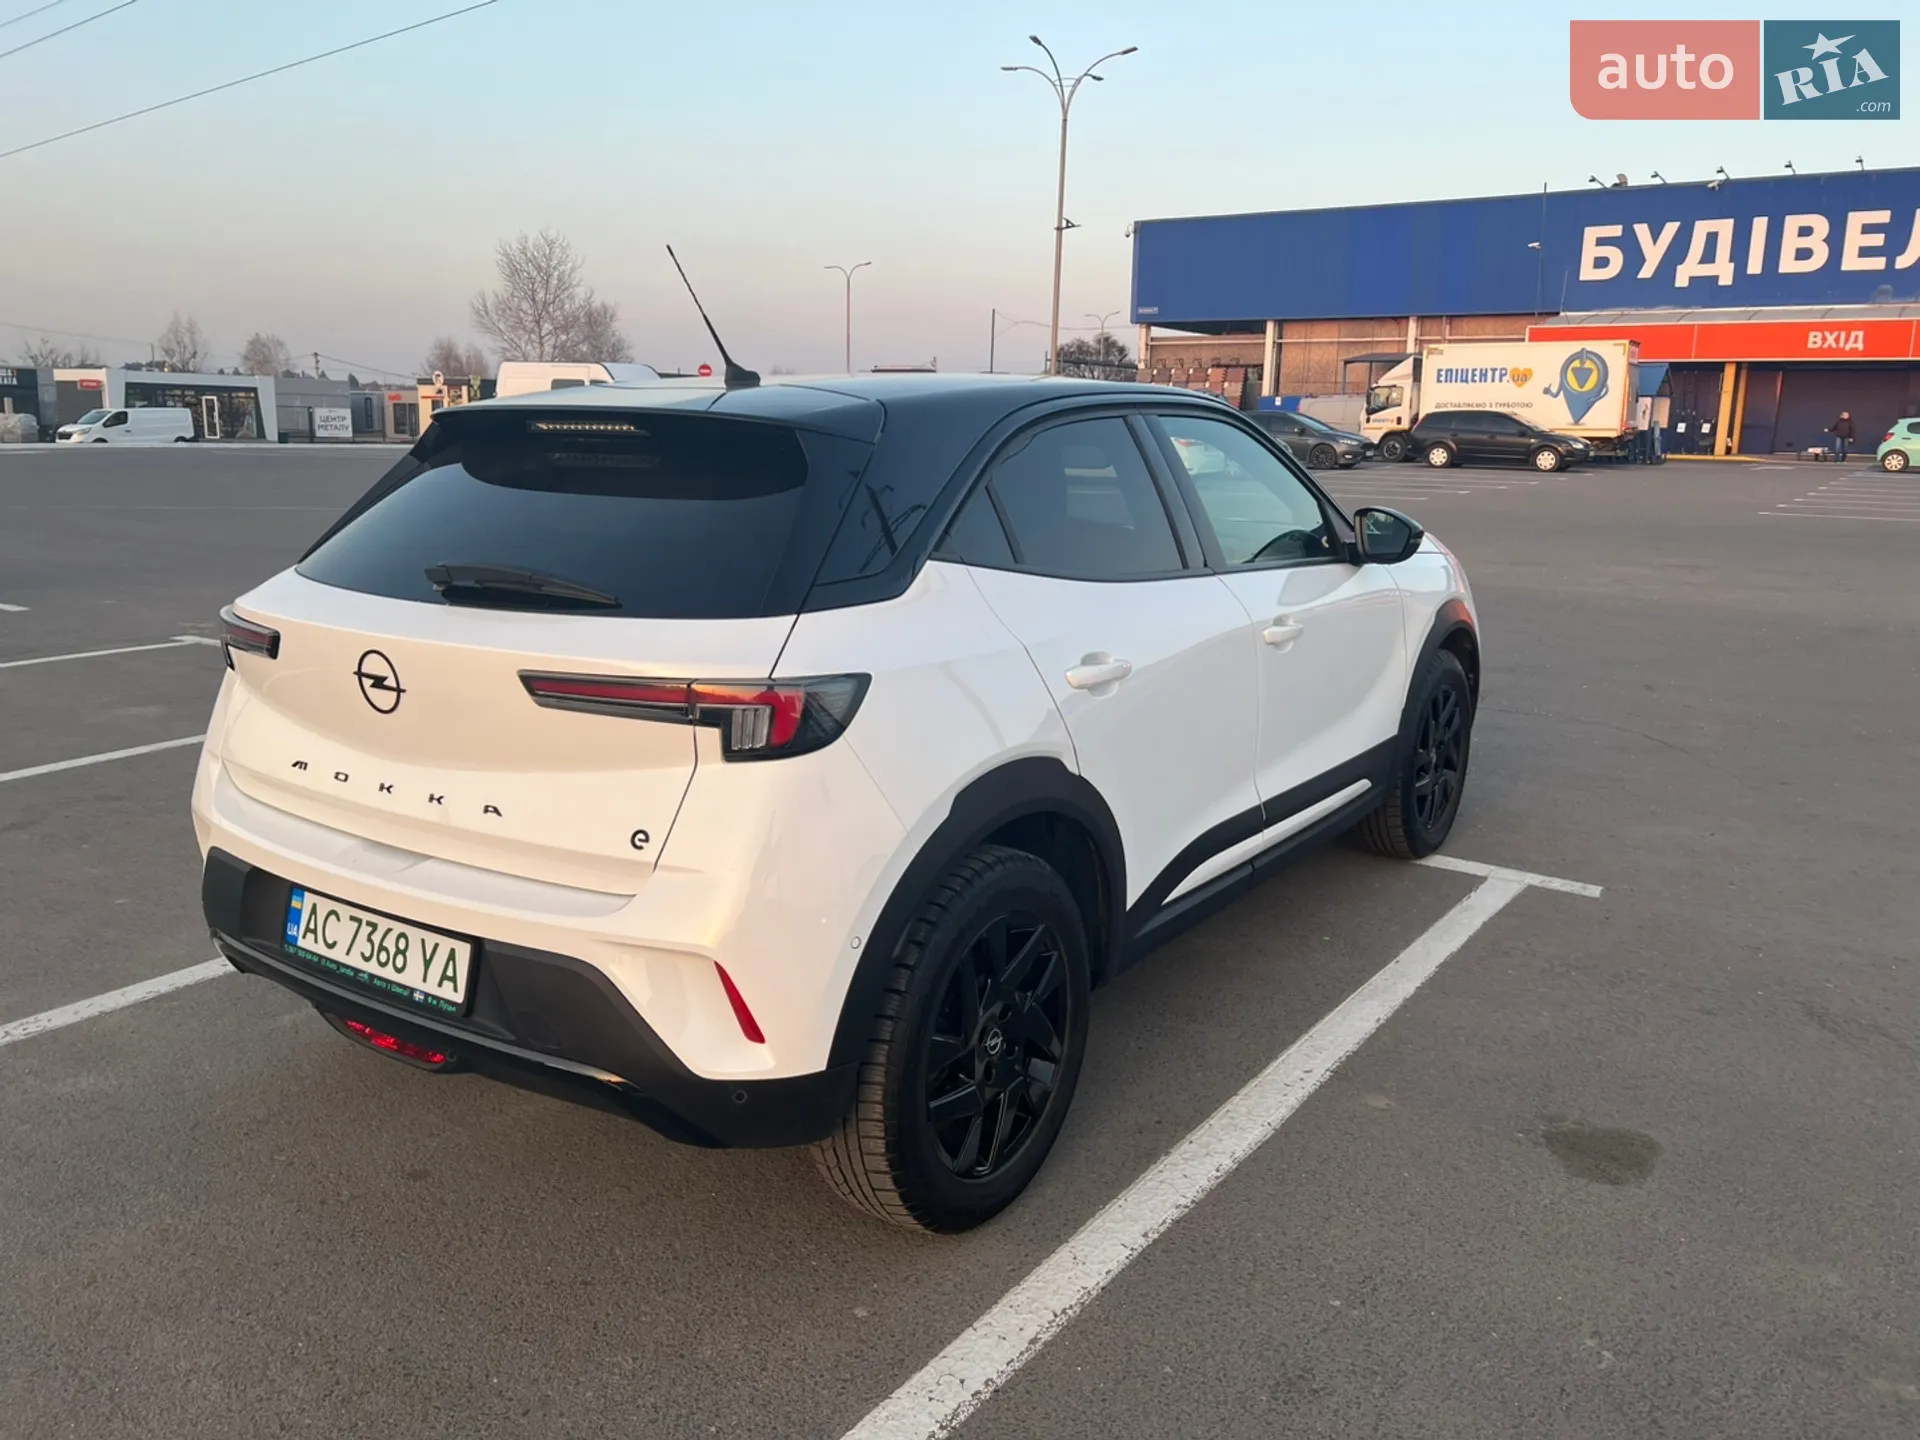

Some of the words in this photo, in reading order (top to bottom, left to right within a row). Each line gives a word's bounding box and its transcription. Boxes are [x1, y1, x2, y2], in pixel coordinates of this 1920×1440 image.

[1806, 330, 1865, 352] ВХІД
[317, 424, 349, 432] МЕТАЛУ
[291, 759, 503, 817] MOKKA
[630, 829, 651, 850] e
[287, 922, 298, 936] UA
[302, 902, 341, 950] AC
[345, 914, 410, 975] 7368
[421, 937, 459, 993] YA
